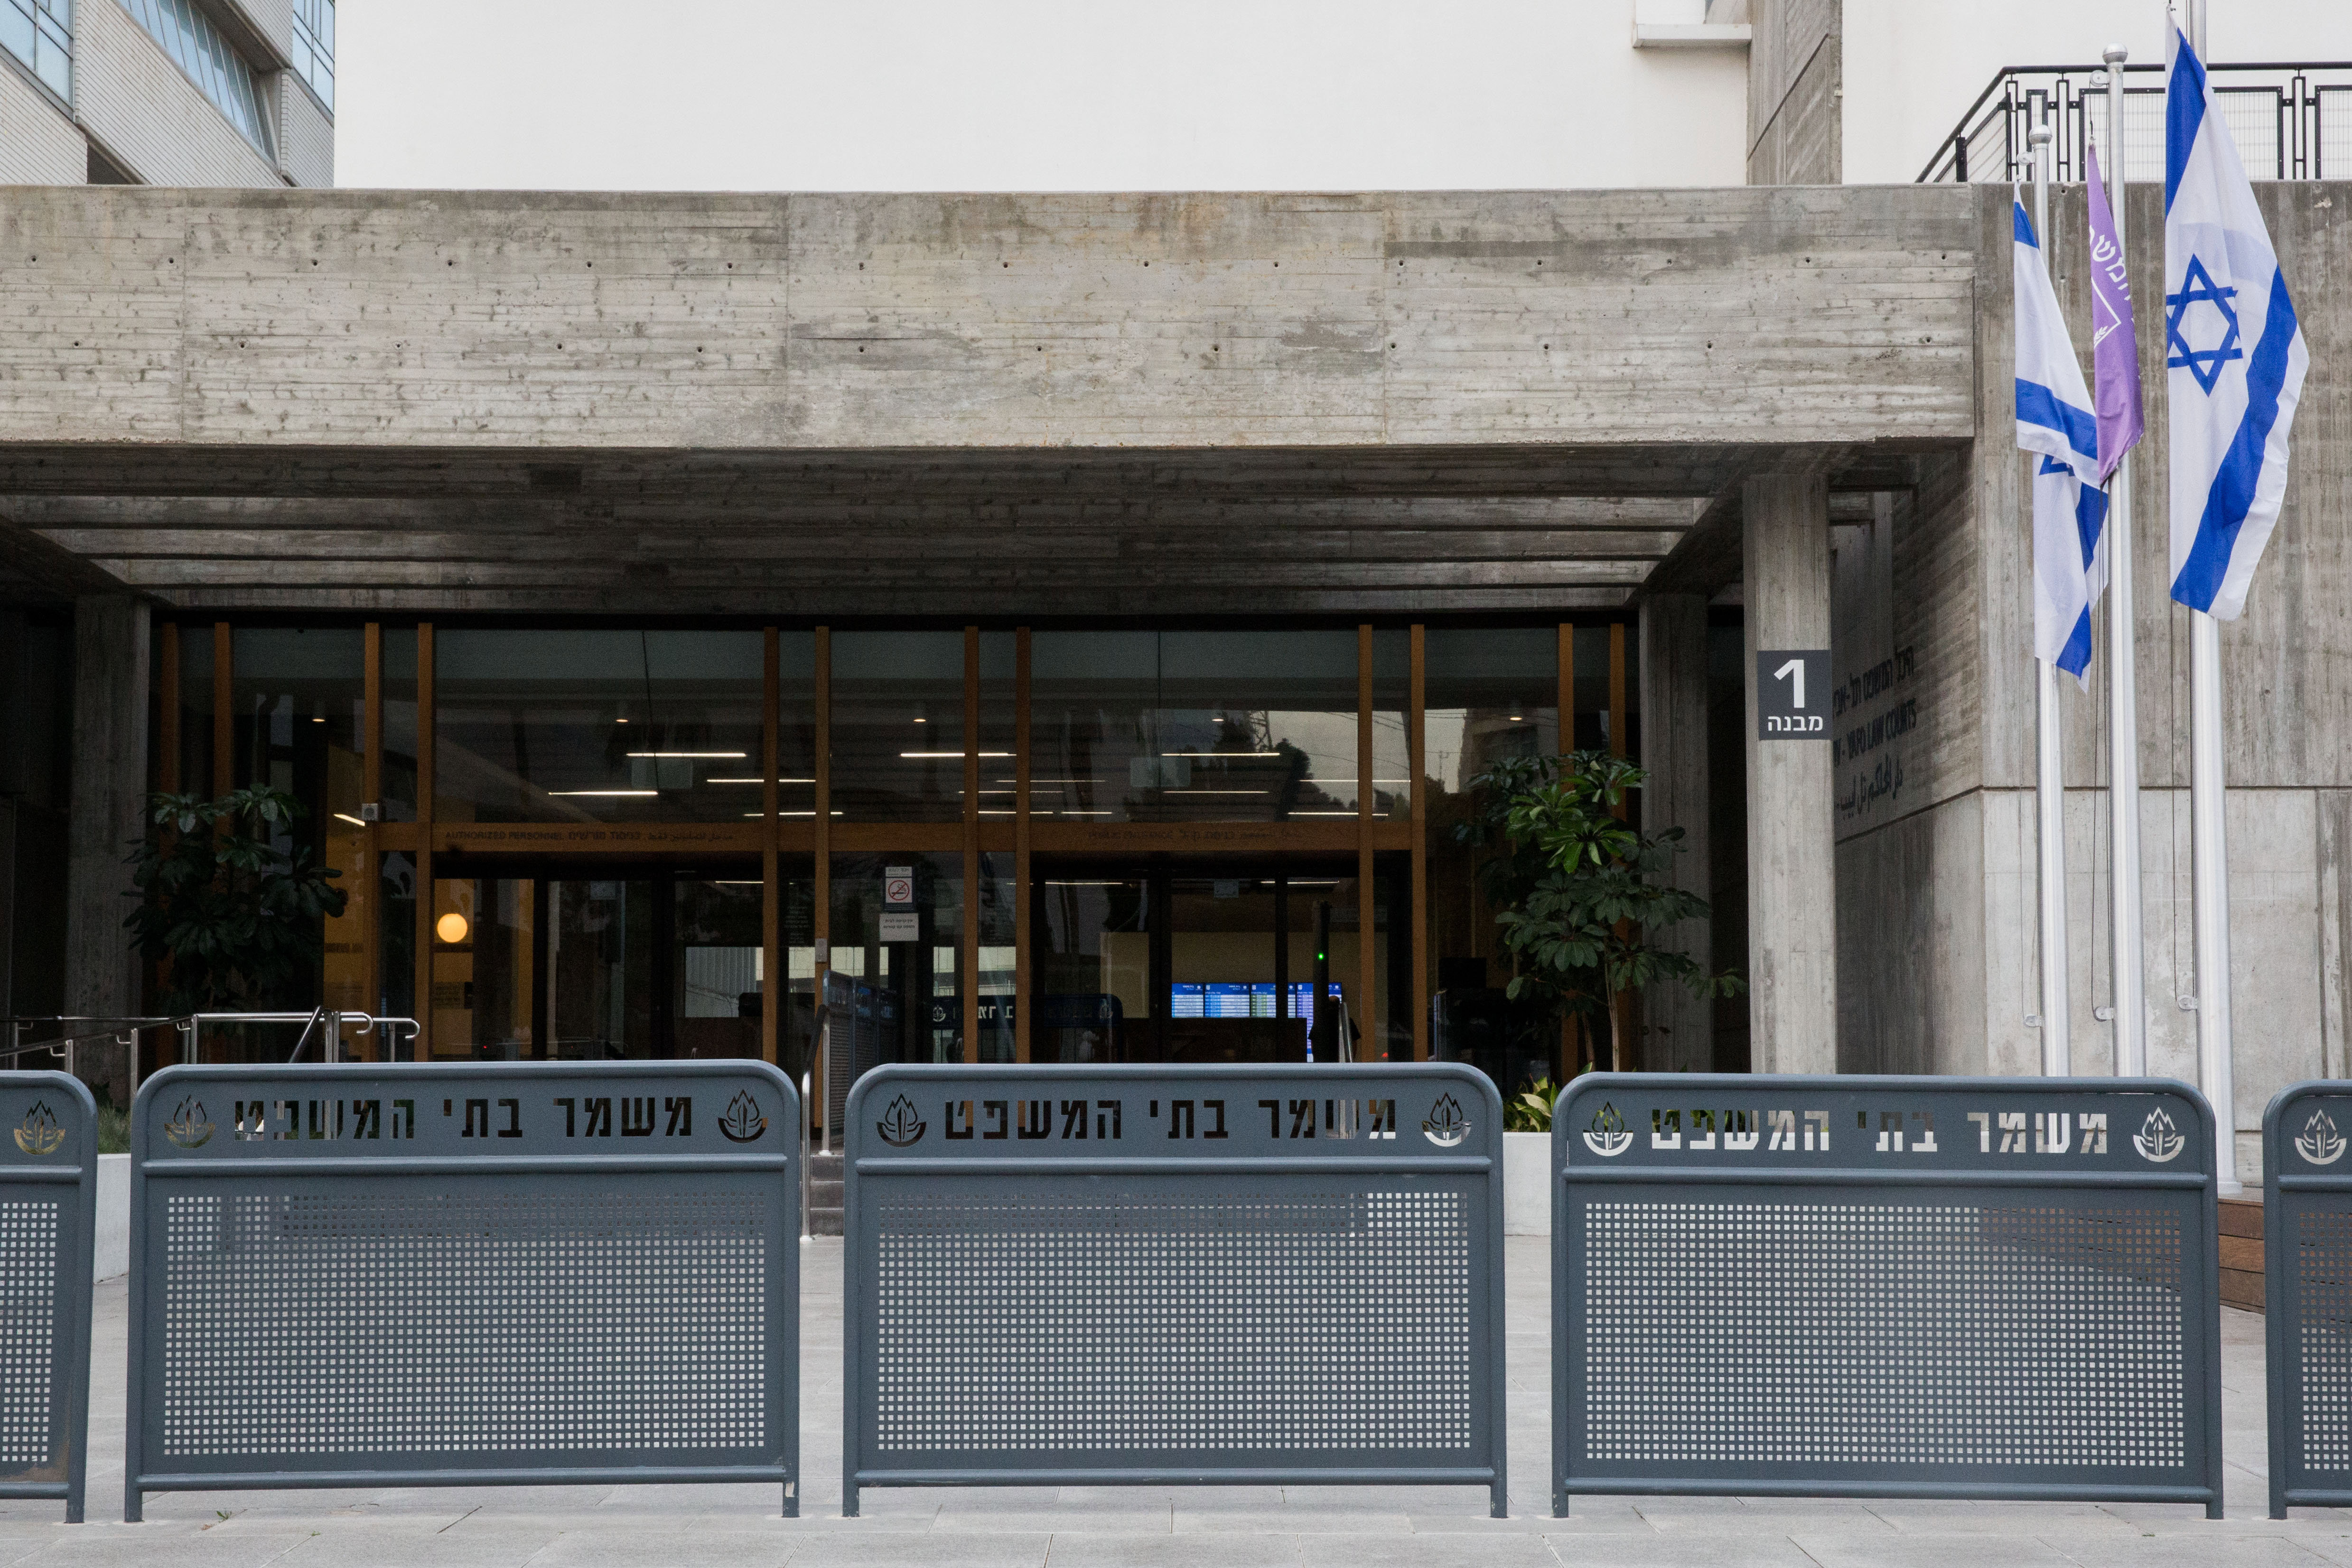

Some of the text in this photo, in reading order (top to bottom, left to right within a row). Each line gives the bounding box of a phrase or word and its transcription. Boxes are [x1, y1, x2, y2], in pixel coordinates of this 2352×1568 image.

[1773, 659, 1804, 708] 1
[1863, 658, 1893, 700] המשפט
[1768, 716, 1823, 731] מבנה
[1847, 726, 1866, 759] YAFO
[1867, 715, 1884, 750] LAW
[1885, 698, 1916, 740] COURTS
[446, 831, 564, 840] AUTHORIZED PERSONNEL
[234, 1097, 692, 1140] משמר בתי המשפט
[945, 1099, 1396, 1140] משמר בתי המשפט
[1652, 1109, 2107, 1154] משמר בתי המשפט
